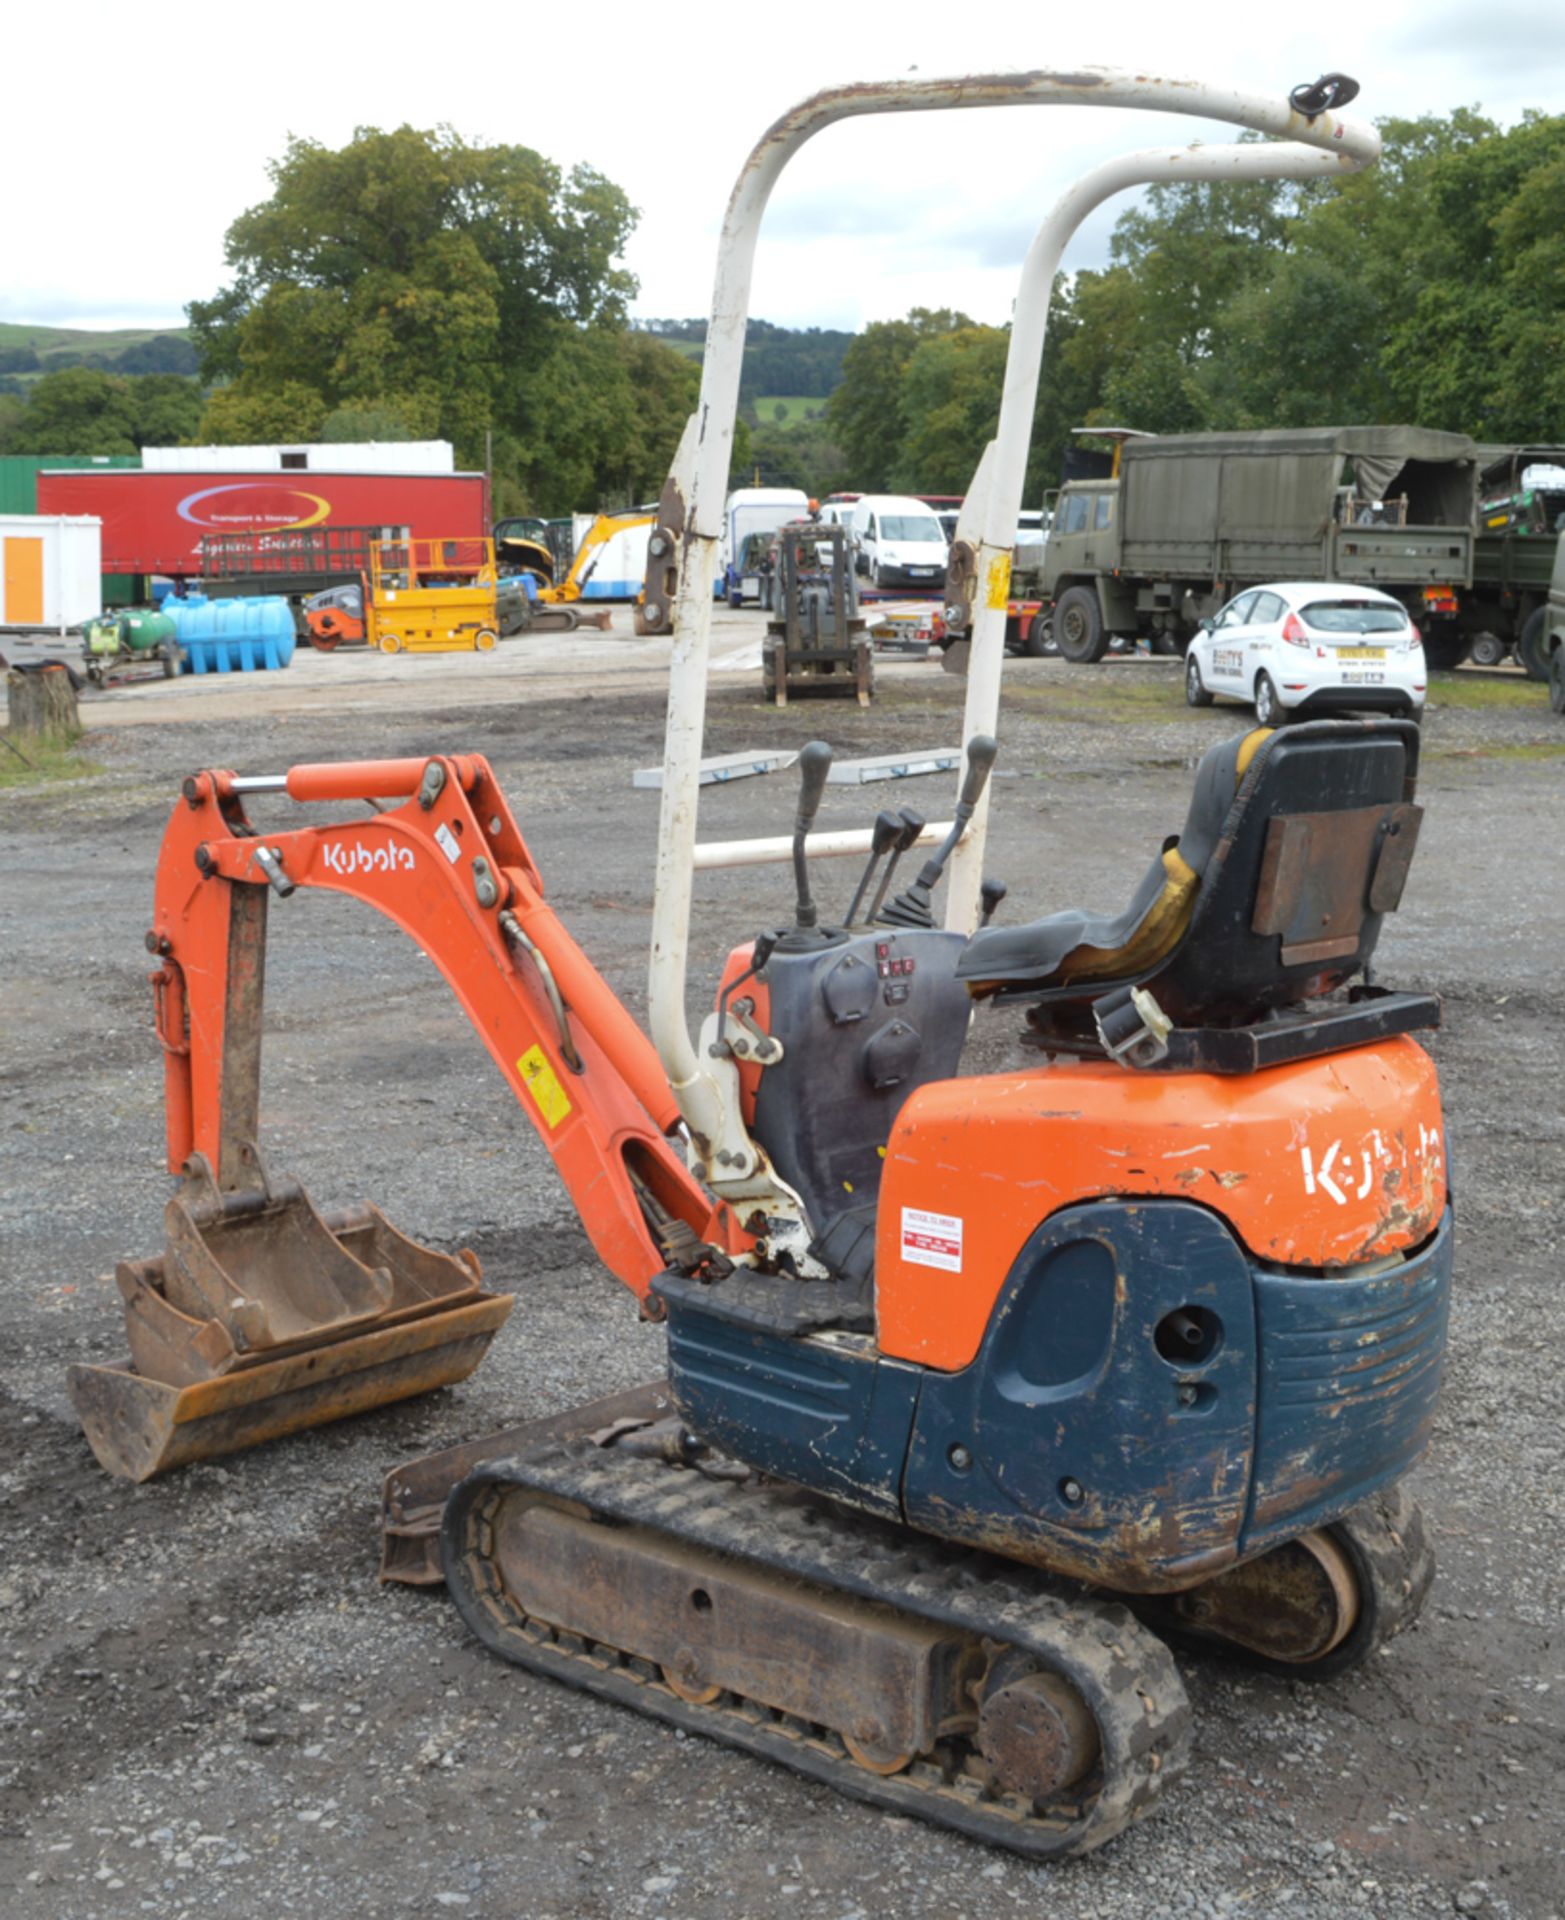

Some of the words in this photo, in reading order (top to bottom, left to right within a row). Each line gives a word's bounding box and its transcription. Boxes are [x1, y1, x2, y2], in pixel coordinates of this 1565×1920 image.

[210, 514, 253, 523] Transport
[264, 514, 299, 523] Storage
[323, 838, 416, 875] Kubota
